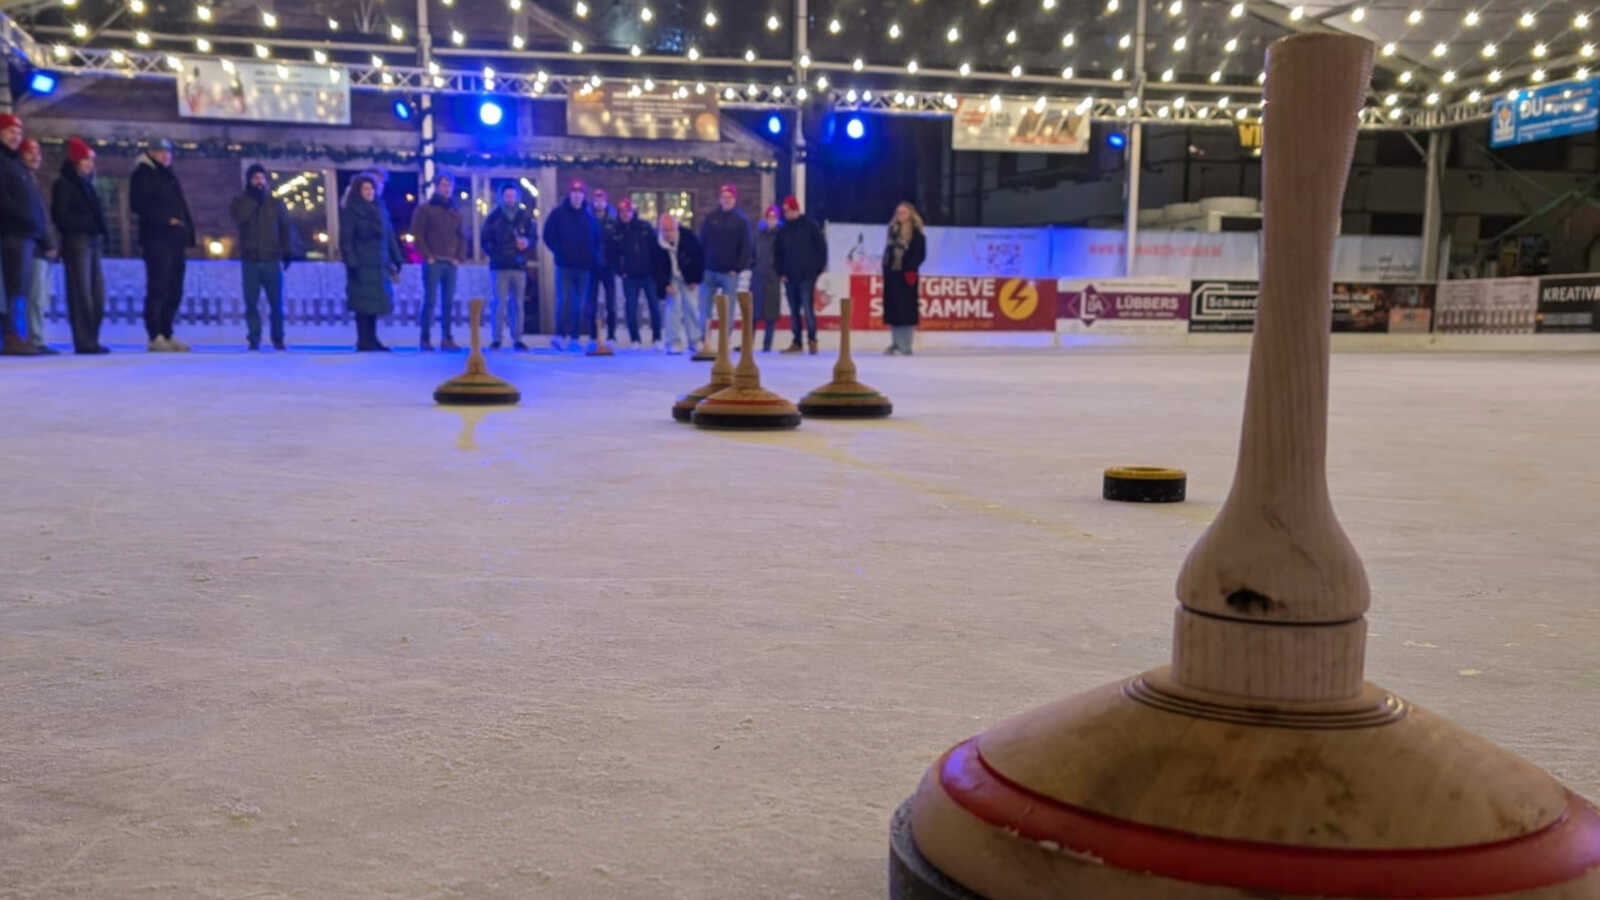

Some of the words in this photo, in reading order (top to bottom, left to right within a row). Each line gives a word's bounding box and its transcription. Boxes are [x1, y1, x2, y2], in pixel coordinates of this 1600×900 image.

[869, 276, 995, 297] HTGREVE
[869, 297, 995, 319] SRAMML
[1115, 294, 1179, 310] LÜBBERS
